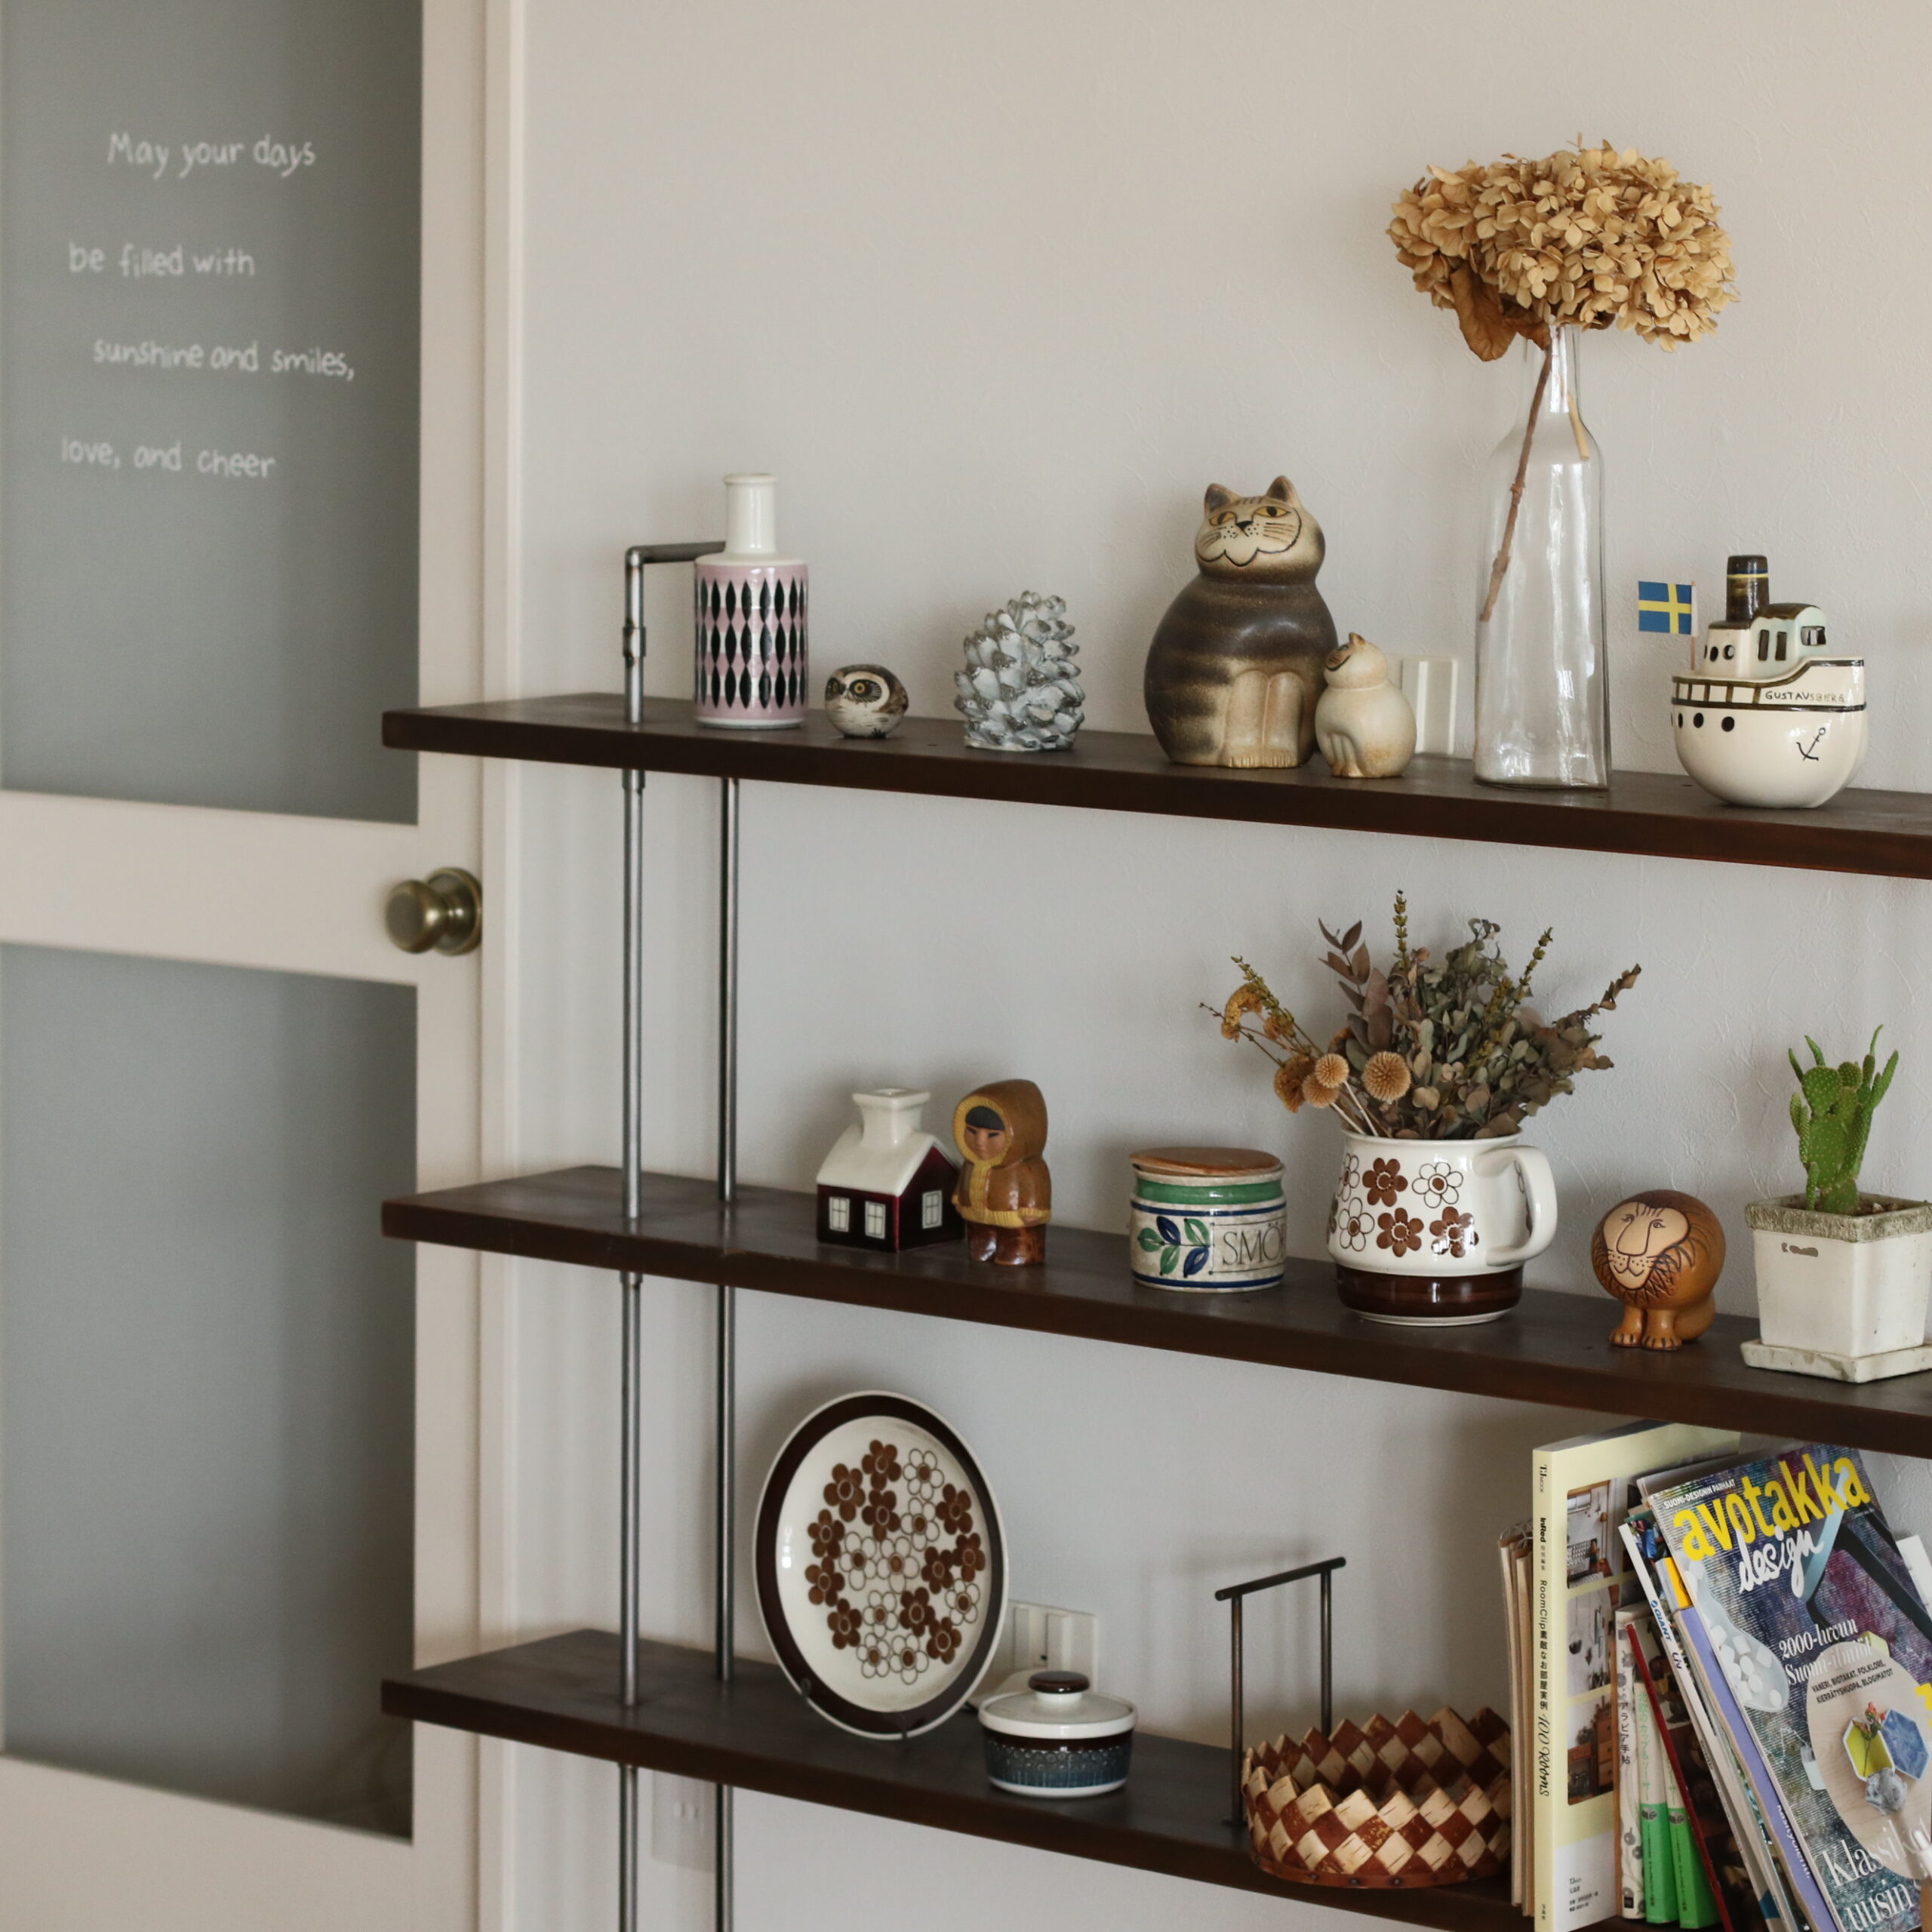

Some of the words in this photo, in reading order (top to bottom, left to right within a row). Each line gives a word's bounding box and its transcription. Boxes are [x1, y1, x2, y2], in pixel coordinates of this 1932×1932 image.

[107, 133, 169, 179] May
[178, 142, 245, 177] your
[253, 133, 316, 177] days
[68, 242, 106, 272] be
[118, 244, 184, 278] filled
[192, 248, 256, 276] with
[92, 340, 205, 368] sunshine
[210, 340, 259, 373] and
[270, 347, 355, 380] smiles,
[60, 435, 121, 469] love,
[134, 441, 183, 472] and
[196, 450, 276, 479] cheer
[1764, 690, 1845, 703] GUSTAVSBERG
[1673, 1453, 1871, 1561] avotakka
[1738, 1525, 1826, 1598] design
[1654, 1608, 1672, 1641] GIANT
[1779, 1618, 1860, 1660] 2000-luvun
[1537, 1714, 1550, 1745] 100
[1844, 1878, 1915, 1931] uusin
